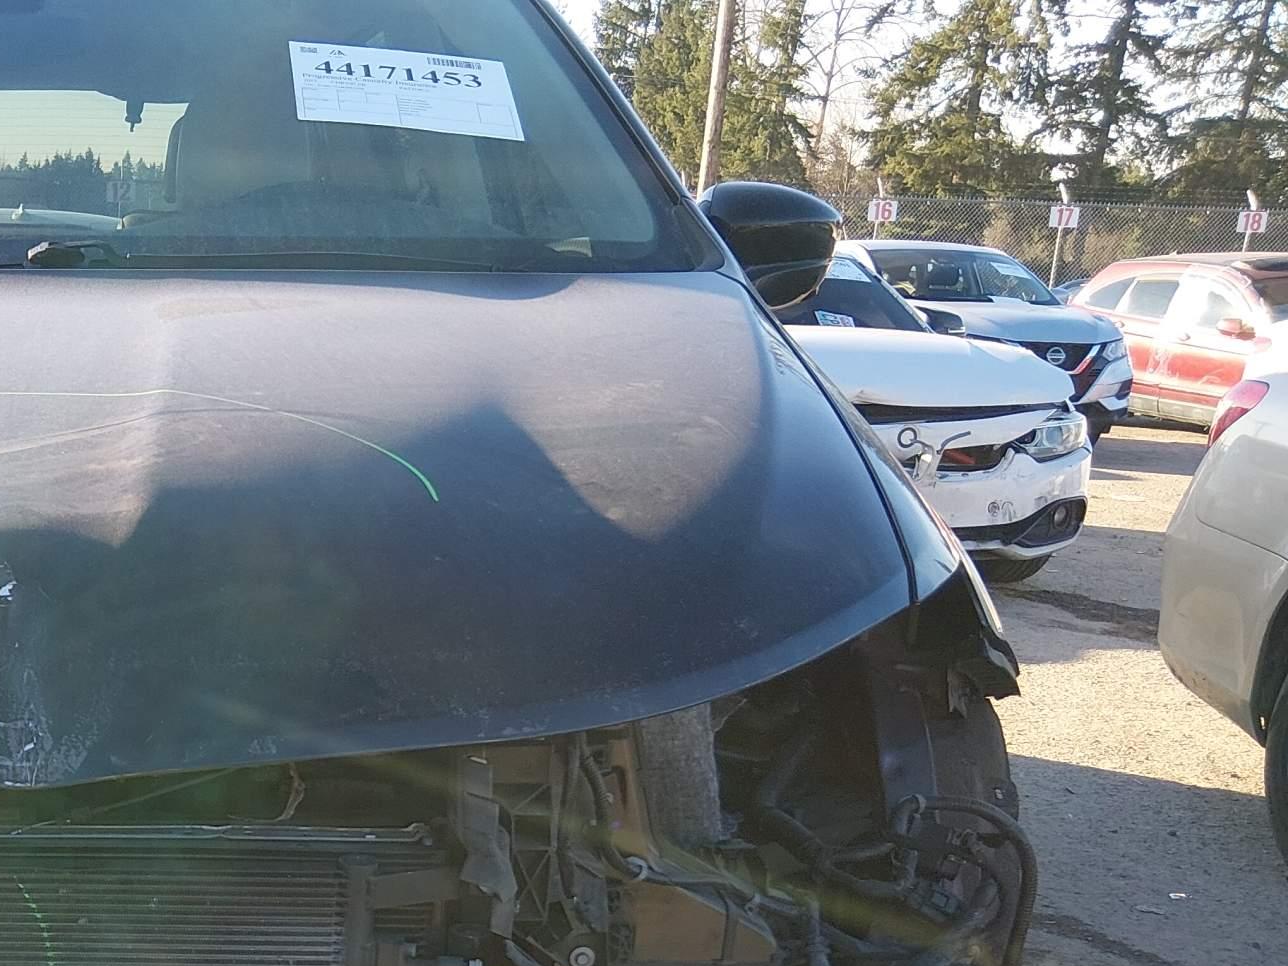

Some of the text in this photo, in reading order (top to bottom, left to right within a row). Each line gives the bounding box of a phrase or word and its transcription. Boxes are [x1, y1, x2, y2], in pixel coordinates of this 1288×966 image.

[314, 60, 482, 88] 44171453
[873, 201, 892, 220] 16
[1057, 207, 1074, 226] 17
[1243, 212, 1263, 231] 18
